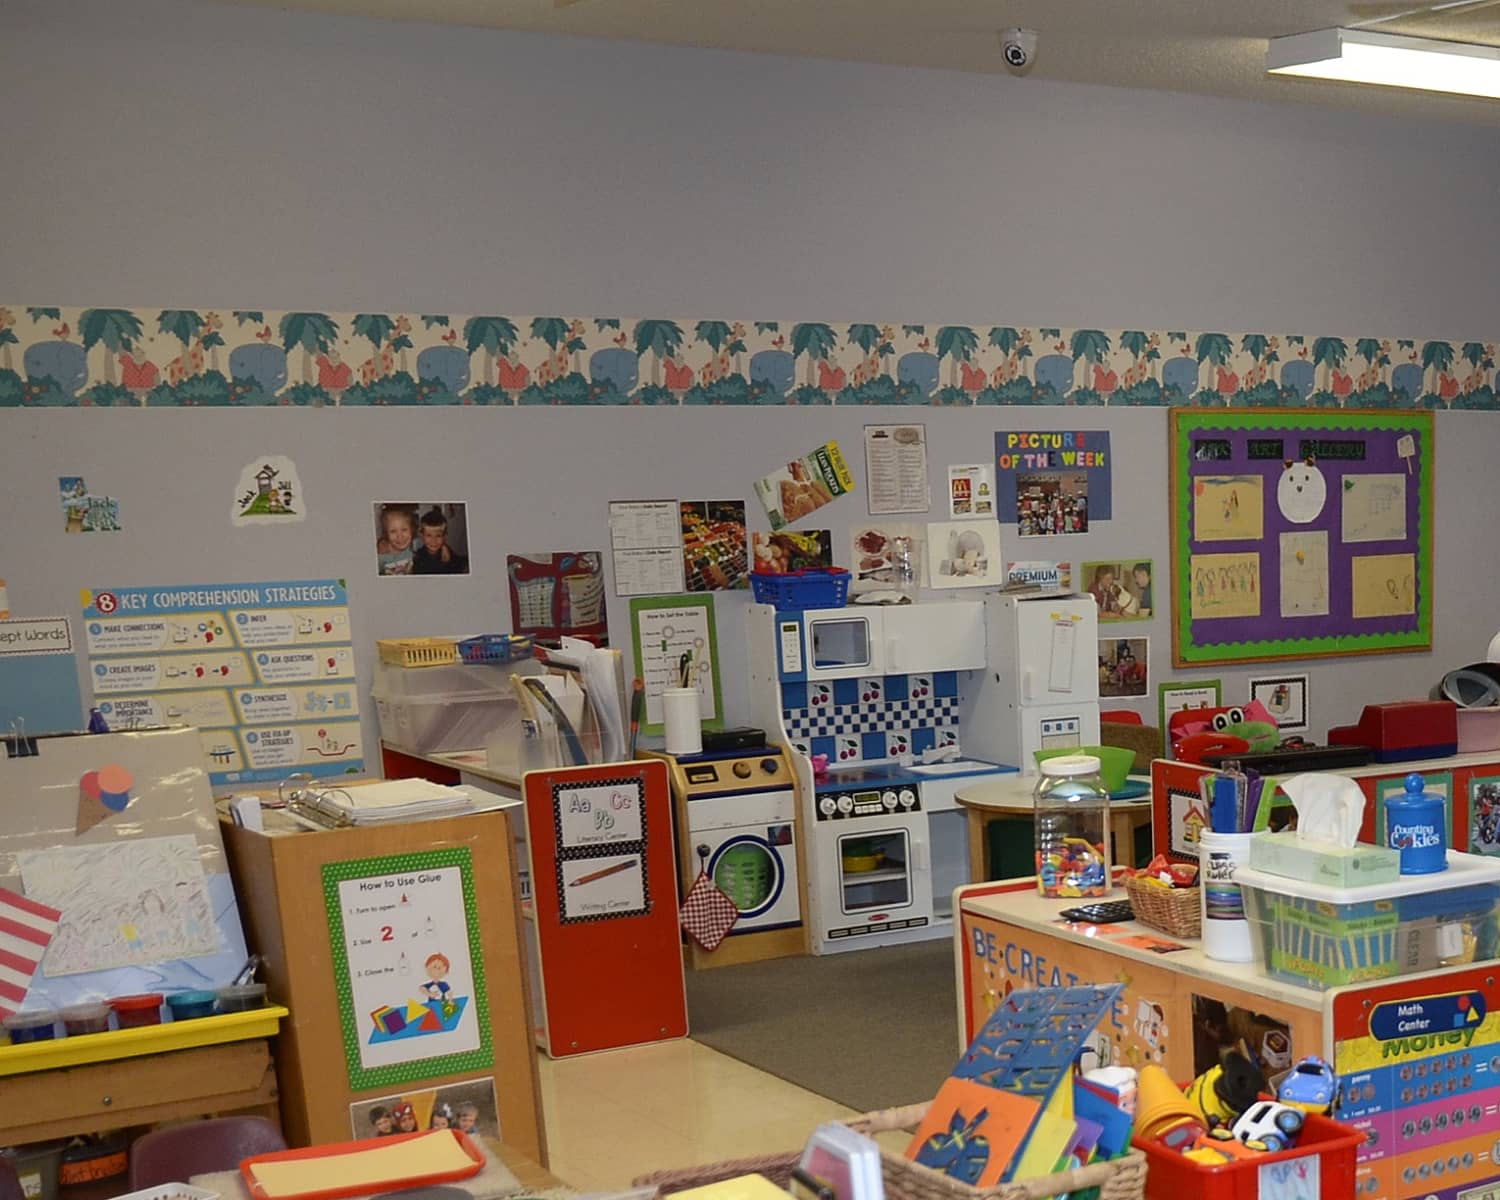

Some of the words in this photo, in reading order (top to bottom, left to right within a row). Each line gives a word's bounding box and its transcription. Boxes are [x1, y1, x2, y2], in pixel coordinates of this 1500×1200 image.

[1007, 431, 1088, 449] PICTURE
[999, 453, 1020, 470] OF
[1024, 450, 1057, 468] THE
[1061, 451, 1105, 467] WEEK
[1009, 571, 1058, 583] PREMIUM
[98, 593, 116, 613] 8
[121, 592, 148, 610] KEY
[153, 588, 260, 608] COMPREHENSION
[264, 585, 337, 603] STRATEGIES
[26, 626, 66, 642] Words
[569, 793, 592, 813] Aa
[609, 790, 632, 810] Cc
[1393, 824, 1435, 838] Counting
[359, 880, 382, 892] How
[384, 879, 395, 889] to
[397, 876, 416, 888] Use
[418, 873, 442, 885] Glue
[380, 925, 395, 942] 2
[972, 926, 998, 965] BE
[1398, 1003, 1424, 1017] Math
[1398, 1018, 1431, 1031] Center
